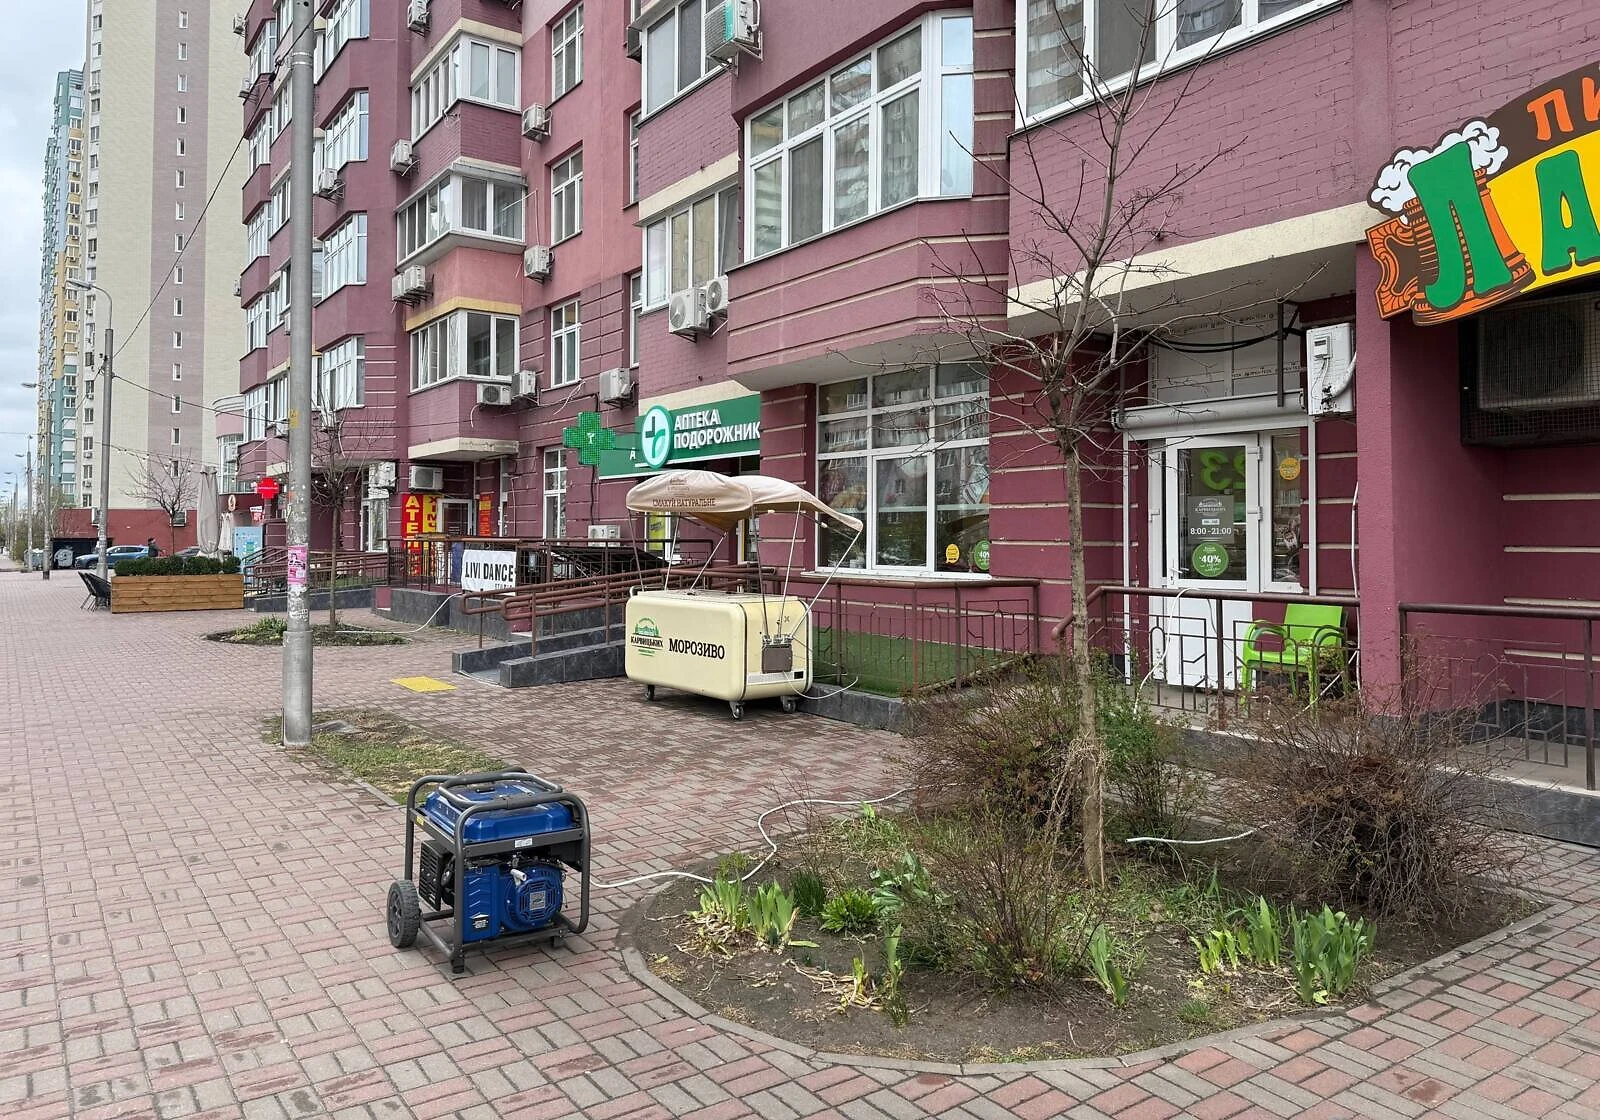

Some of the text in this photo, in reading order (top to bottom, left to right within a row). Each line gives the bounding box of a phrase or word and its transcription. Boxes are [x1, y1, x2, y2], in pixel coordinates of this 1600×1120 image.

[674, 409, 721, 430] АПТЕКА
[673, 421, 760, 450] ПОДОРОЖНИК
[483, 563, 514, 582] DANCE
[668, 638, 725, 660] МОРОЗИВО
